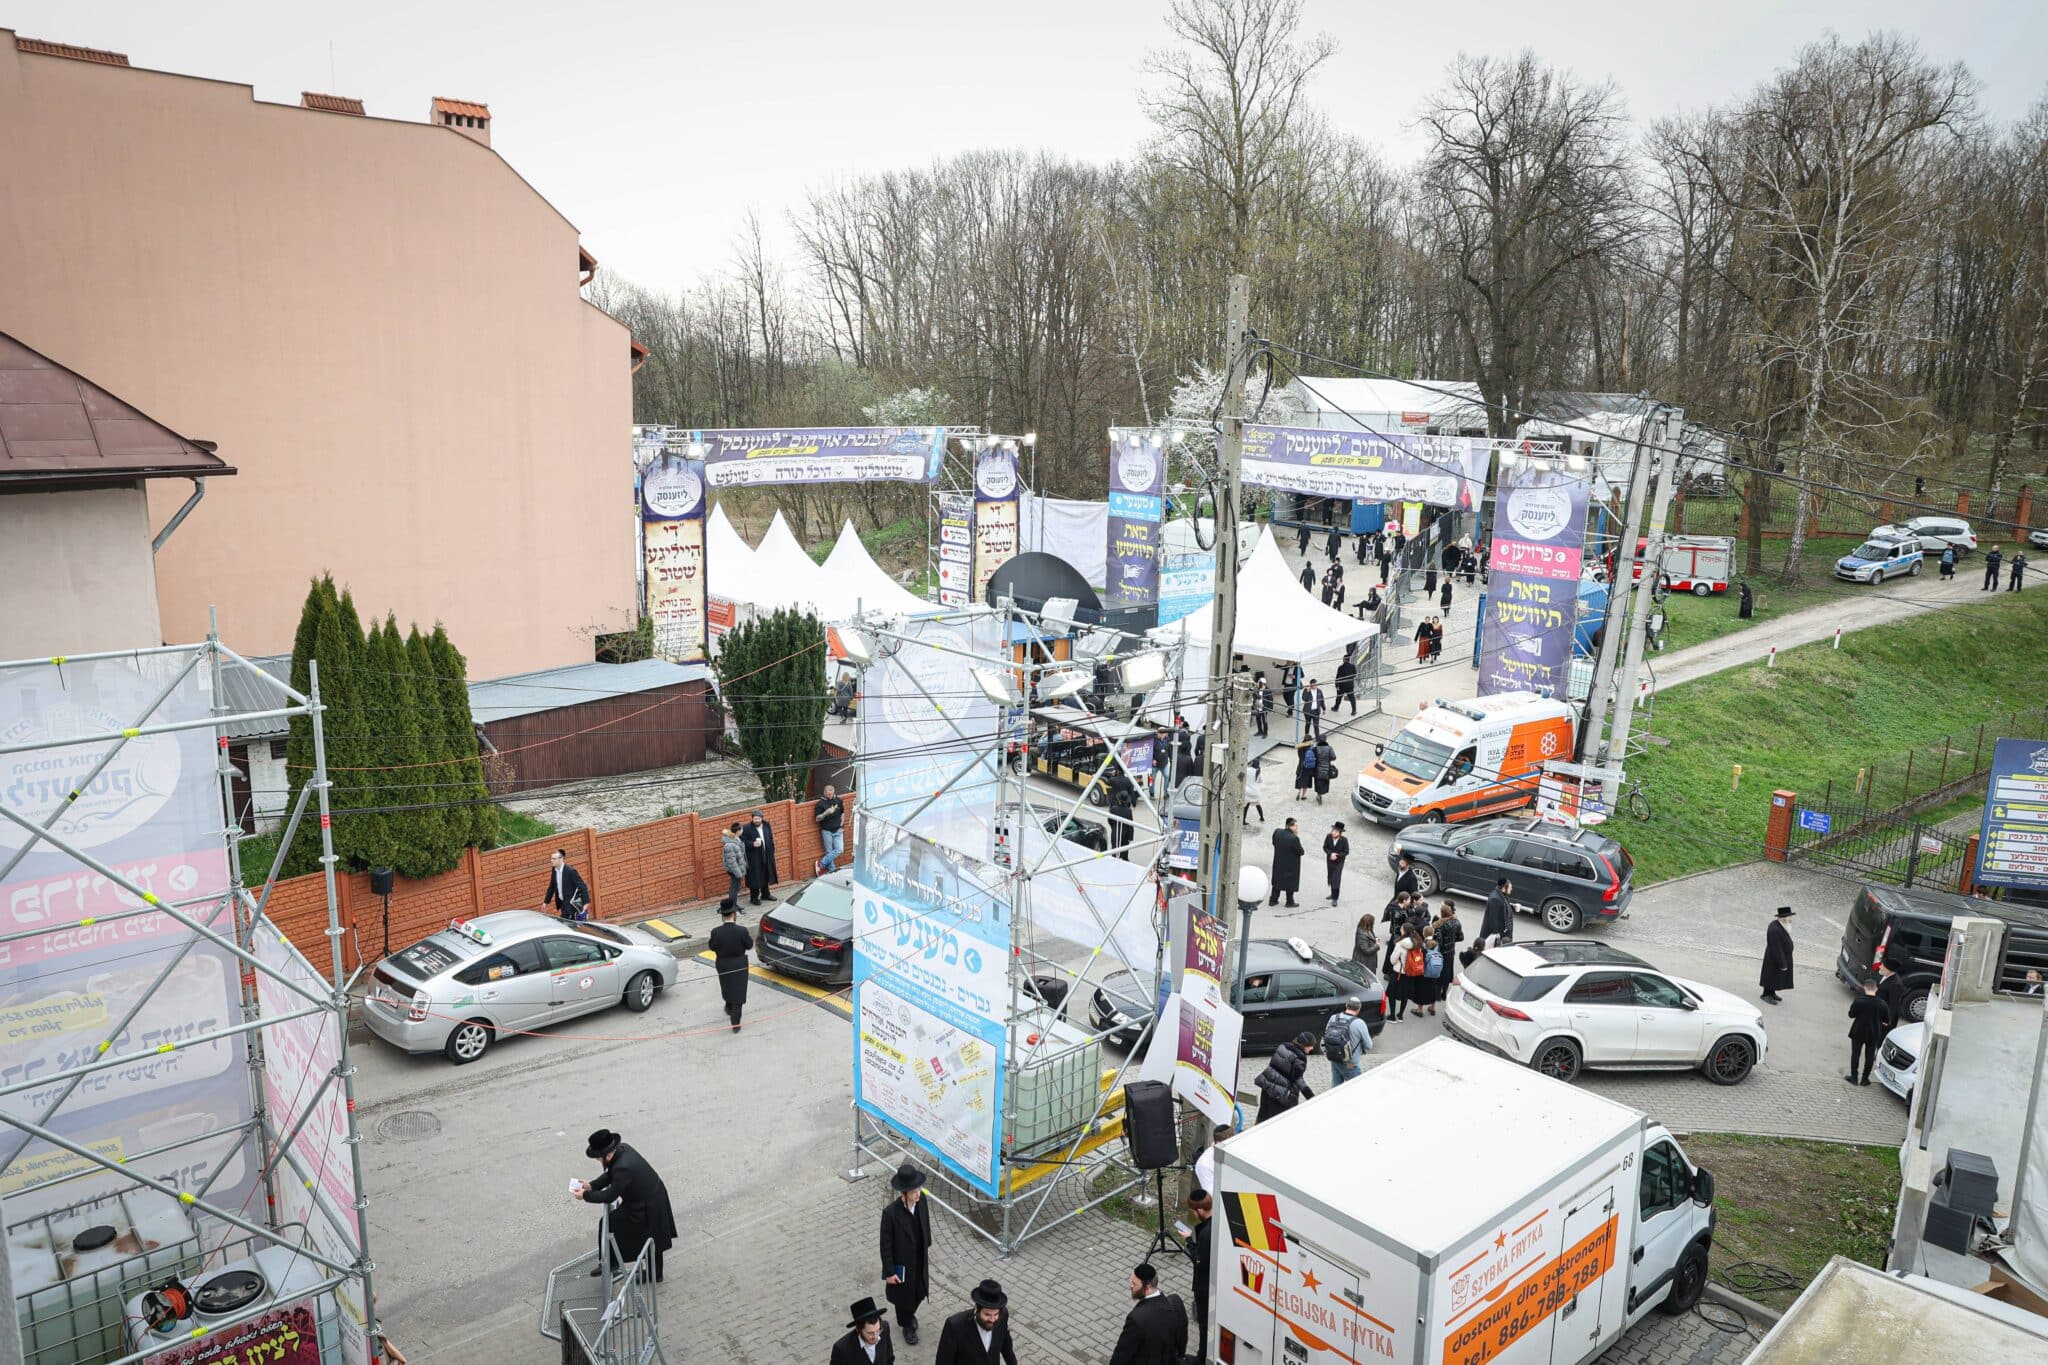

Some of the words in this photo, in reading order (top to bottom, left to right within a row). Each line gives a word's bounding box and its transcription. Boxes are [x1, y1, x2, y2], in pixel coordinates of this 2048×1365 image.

[1511, 543, 1554, 563] פרויען
[883, 901, 958, 966] מענער
[1622, 1152, 1634, 1171] 68
[1452, 1301, 1512, 1353] dostawy
[1516, 1280, 1539, 1306] dla
[1542, 1225, 1612, 1290] gastronomii
[1471, 1256, 1510, 1298] SZYBKA
[1510, 1223, 1544, 1264] FRYTKA
[1268, 1283, 1338, 1333] BELGIJSKA
[1342, 1317, 1395, 1359] FRYTKA
[1497, 1258, 1599, 1347] 886-788-788
